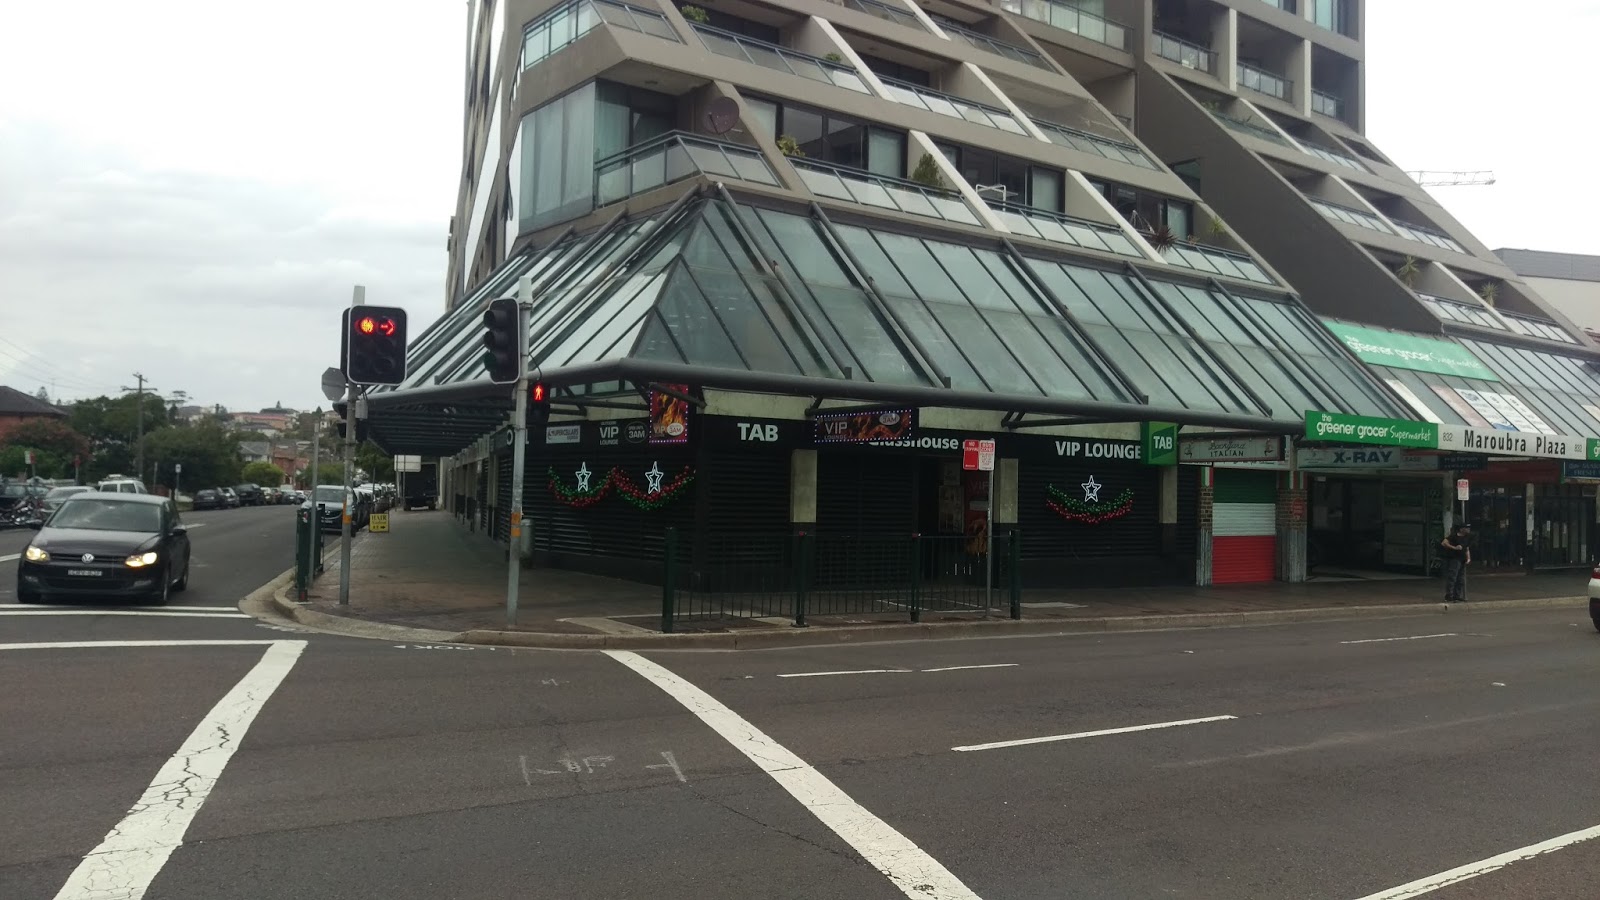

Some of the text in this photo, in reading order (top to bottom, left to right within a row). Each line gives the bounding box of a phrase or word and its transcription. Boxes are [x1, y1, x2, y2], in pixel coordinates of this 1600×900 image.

[1322, 413, 1332, 422] the
[599, 426, 619, 439] VIP
[628, 430, 645, 439] 3AM
[737, 422, 778, 442] TAB
[825, 421, 848, 434] VIP
[1316, 422, 1431, 443] greener grocer Supermarket
[1055, 440, 1081, 456] VIP
[1153, 435, 1173, 450] TAB
[1464, 429, 1526, 452] Maroubra
[1536, 436, 1566, 455] Plaza
[1084, 442, 1141, 460] LOUNGE
[1210, 450, 1244, 458] ITALIAN
[1333, 450, 1393, 464] X-RAY
